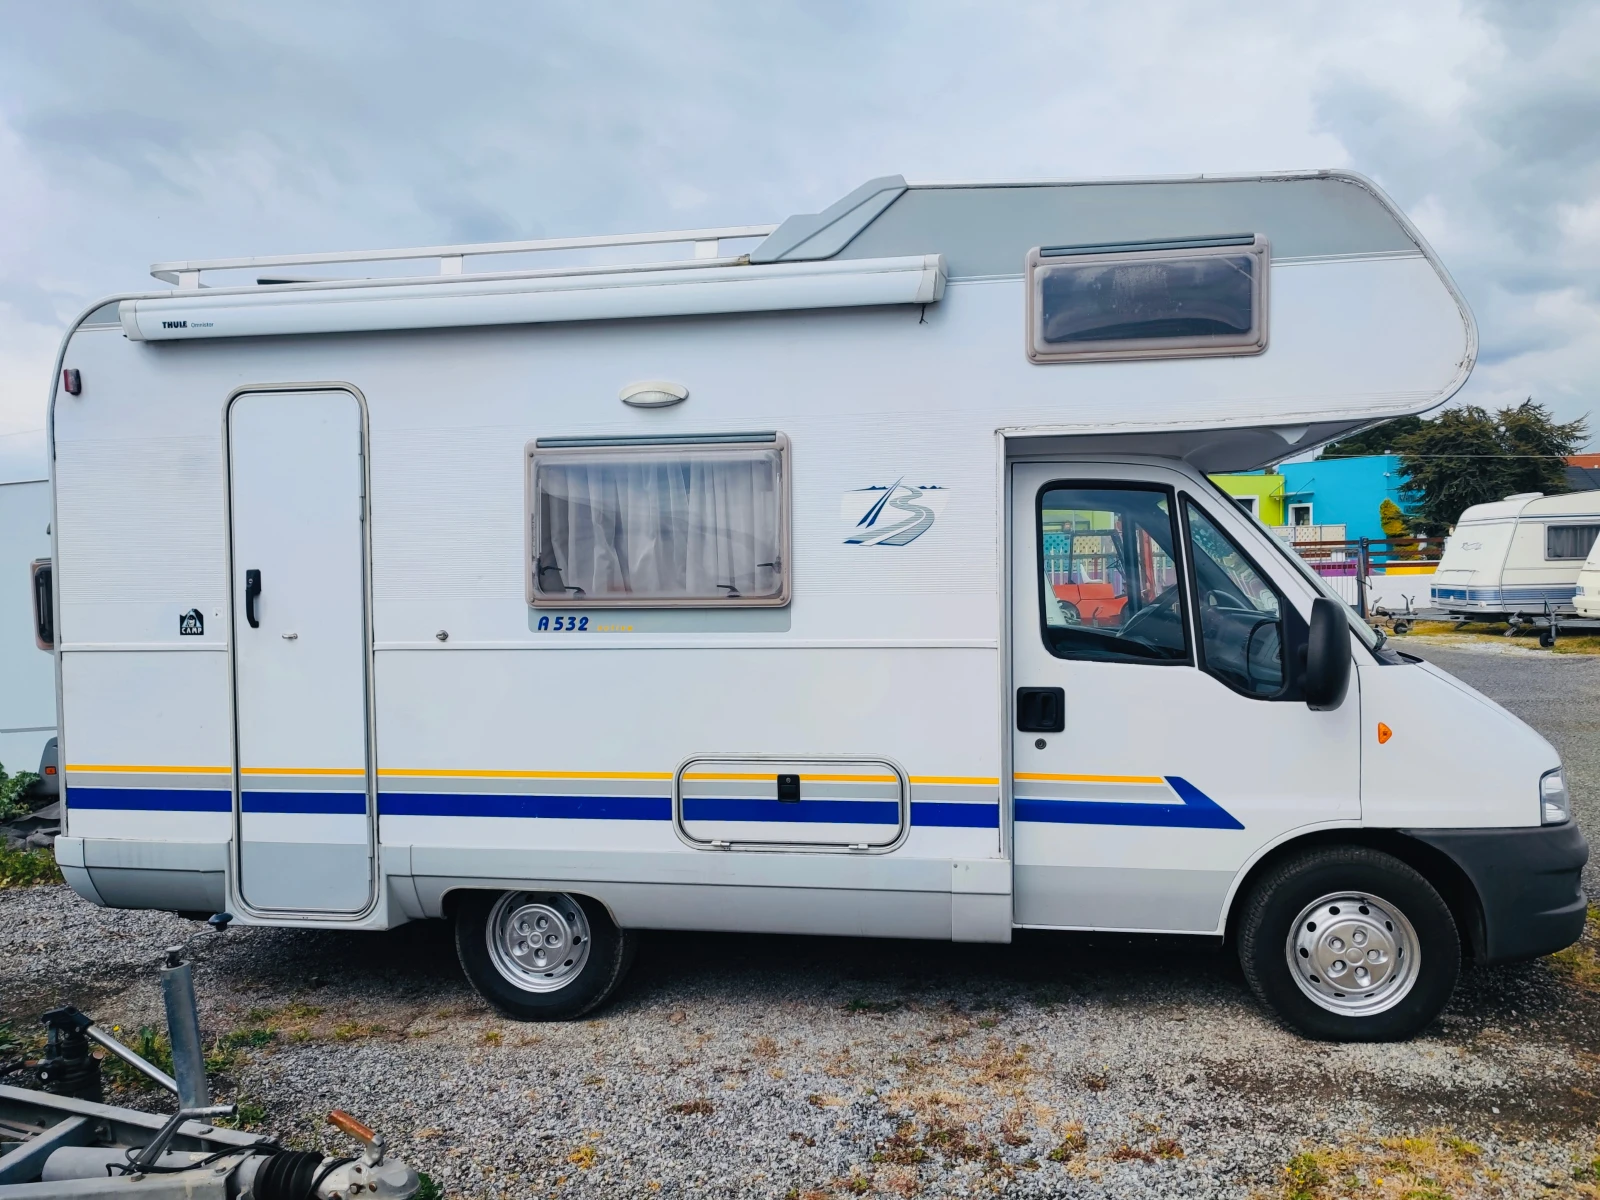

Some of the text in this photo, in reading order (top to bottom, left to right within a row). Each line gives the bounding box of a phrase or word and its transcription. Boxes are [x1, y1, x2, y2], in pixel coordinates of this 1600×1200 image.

[162, 320, 188, 329] THULE
[537, 615, 550, 631] A
[553, 616, 589, 631] 532
